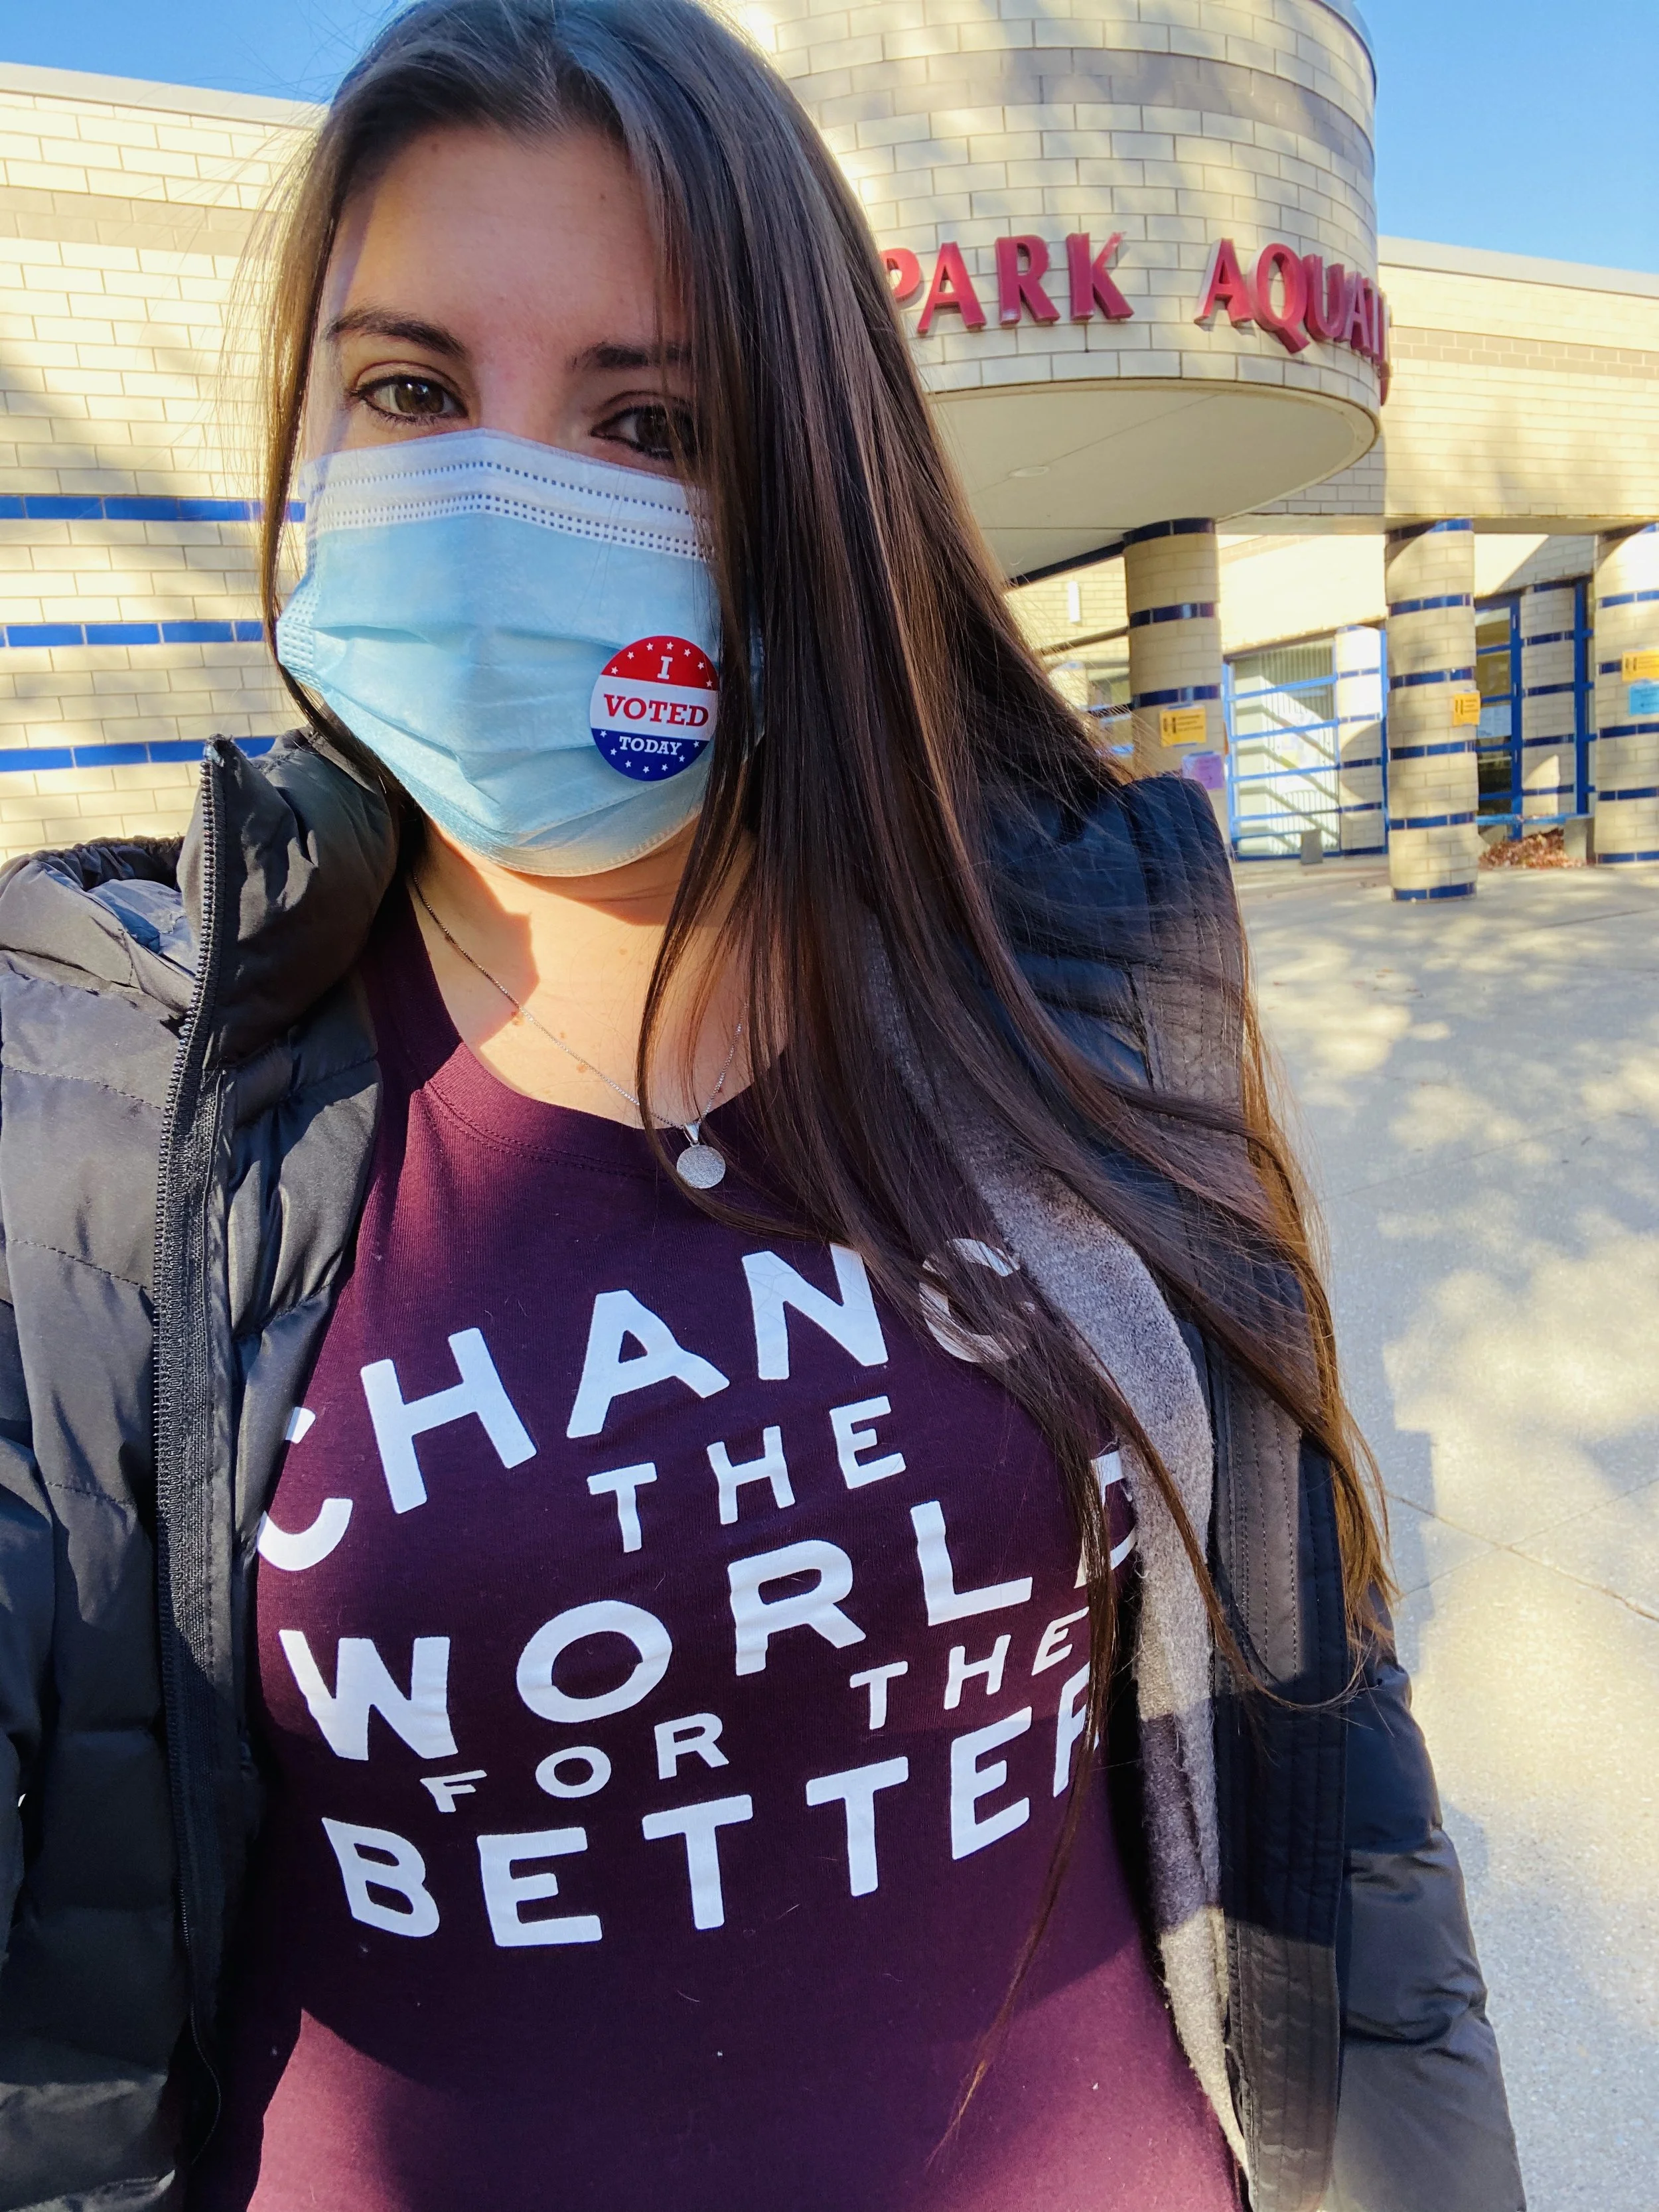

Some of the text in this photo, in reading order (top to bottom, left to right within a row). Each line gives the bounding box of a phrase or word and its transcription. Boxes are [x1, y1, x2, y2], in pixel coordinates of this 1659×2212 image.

[657, 656, 673, 680] I
[604, 694, 709, 727] VOTED
[619, 736, 682, 756] TODAY
[587, 1396, 906, 1553] THE
[419, 1606, 1090, 1813] FOR THE
